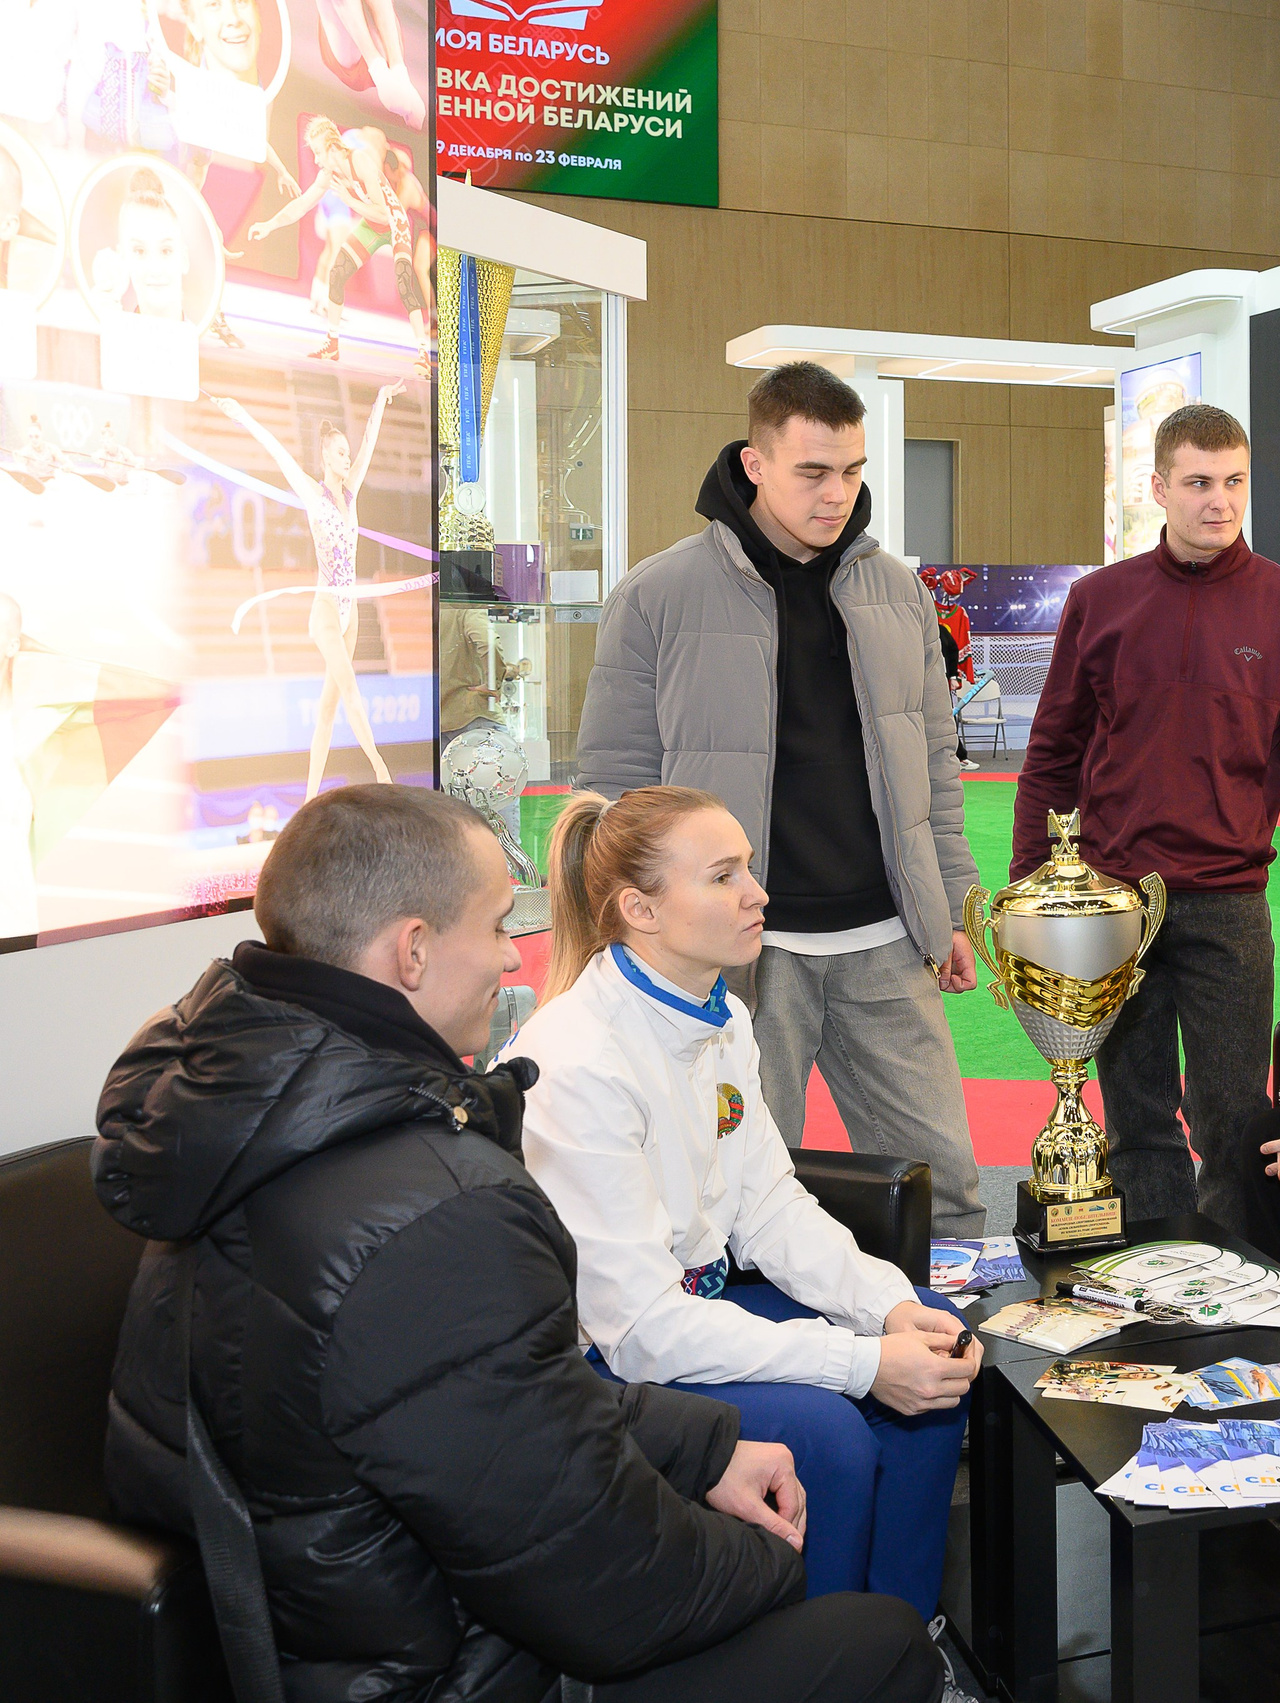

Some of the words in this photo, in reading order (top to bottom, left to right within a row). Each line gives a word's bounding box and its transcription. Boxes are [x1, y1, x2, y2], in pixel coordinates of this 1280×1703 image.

[488, 33, 610, 65] БЕЛАРУСЬ
[436, 67, 492, 93] ВКА
[497, 74, 692, 114] ДОСТИЖЕНИЙ
[438, 95, 535, 125] ЕННОЙ
[543, 106, 683, 139] БЕЛАРУСИ
[448, 144, 512, 160] ДЕКАБРЯ
[515, 152, 533, 162] по
[535, 150, 556, 165] 23
[558, 153, 622, 170] ФЕВРАЛЯ
